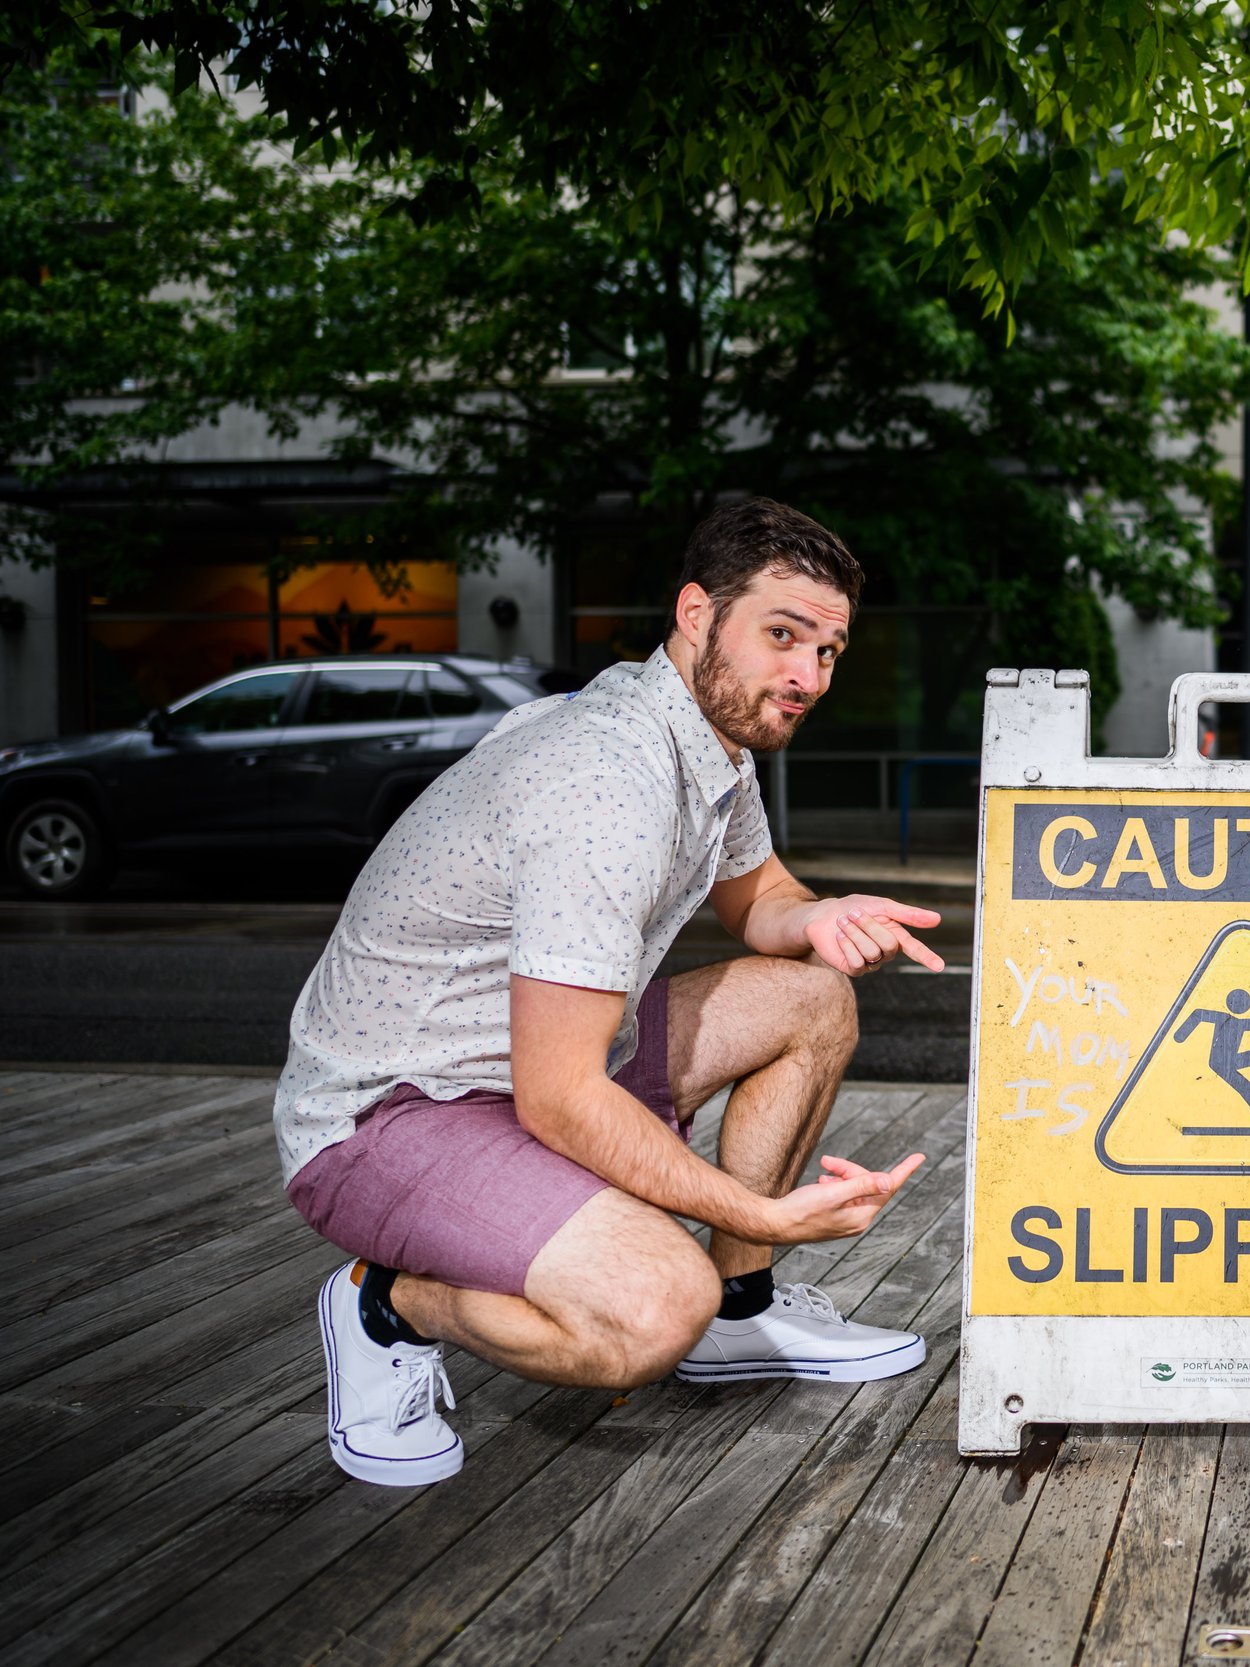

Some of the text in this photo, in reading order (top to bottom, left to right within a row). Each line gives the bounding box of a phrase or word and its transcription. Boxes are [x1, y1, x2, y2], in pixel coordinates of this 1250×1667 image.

[1004, 956, 1130, 1028] YOUR
[1026, 1020, 1131, 1081] MOM
[1000, 1077, 1094, 1136] IS
[1183, 1362, 1234, 1371] PORTLAND
[1183, 1376, 1207, 1384] Healthy
